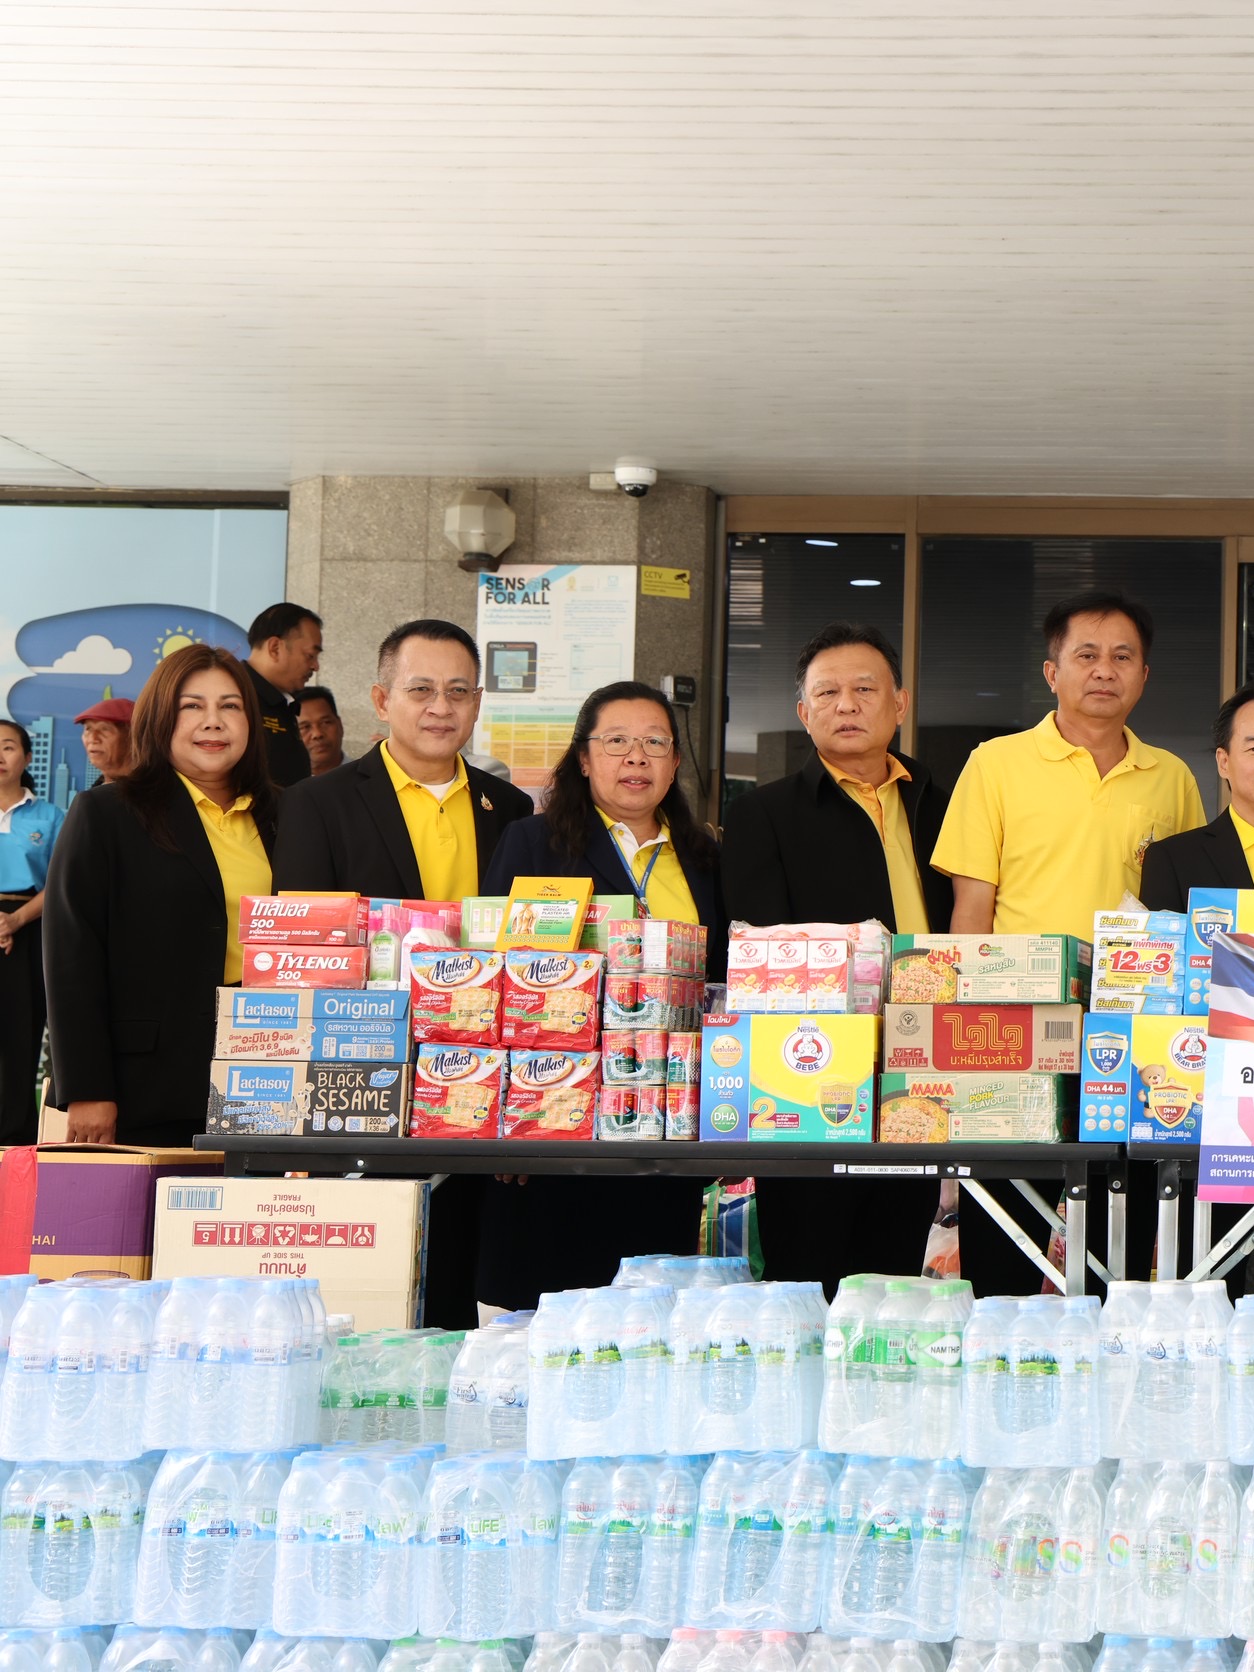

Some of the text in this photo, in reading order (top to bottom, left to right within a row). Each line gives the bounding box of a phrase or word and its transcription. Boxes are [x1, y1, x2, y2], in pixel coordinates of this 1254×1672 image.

[644, 571, 663, 579] CCTV
[485, 591, 550, 605] FOR ALL
[249, 919, 275, 928] 500
[1201, 923, 1222, 933] LPR
[276, 952, 350, 970] TYLENOL
[927, 945, 962, 965] มาม่า
[1110, 950, 1139, 971] 12
[1152, 952, 1172, 974] 3
[276, 971, 301, 980] 500
[431, 956, 474, 981] Malkist
[525, 957, 568, 983] Malkist
[236, 997, 296, 1024] Lactasoy
[324, 998, 395, 1018] Original
[327, 1023, 358, 1032] รสหวาน
[272, 1032, 279, 1042] 9
[1096, 1049, 1117, 1059] LPR
[430, 1052, 472, 1076] Malkist
[523, 1056, 567, 1081] Malkist
[795, 1062, 820, 1071] BEBE
[230, 1070, 291, 1096] Lactasoy
[317, 1072, 366, 1087] BLACK
[708, 1076, 743, 1090] 1,000
[911, 1083, 955, 1096] MAMA
[969, 1082, 1004, 1095] MINCED
[1102, 1084, 1114, 1092] 44
[315, 1089, 392, 1111] SESAME
[969, 1092, 994, 1103] PORK
[969, 1095, 1010, 1111] FLAVOUR
[714, 1112, 736, 1121] DHA
[752, 1096, 777, 1129] 2
[257, 1203, 315, 1217] โปรดอย่าโยน
[32, 1235, 56, 1245] HAI
[202, 1231, 210, 1242] 5
[258, 1262, 307, 1279] ด้านบน
[470, 1518, 499, 1534] LIFE
